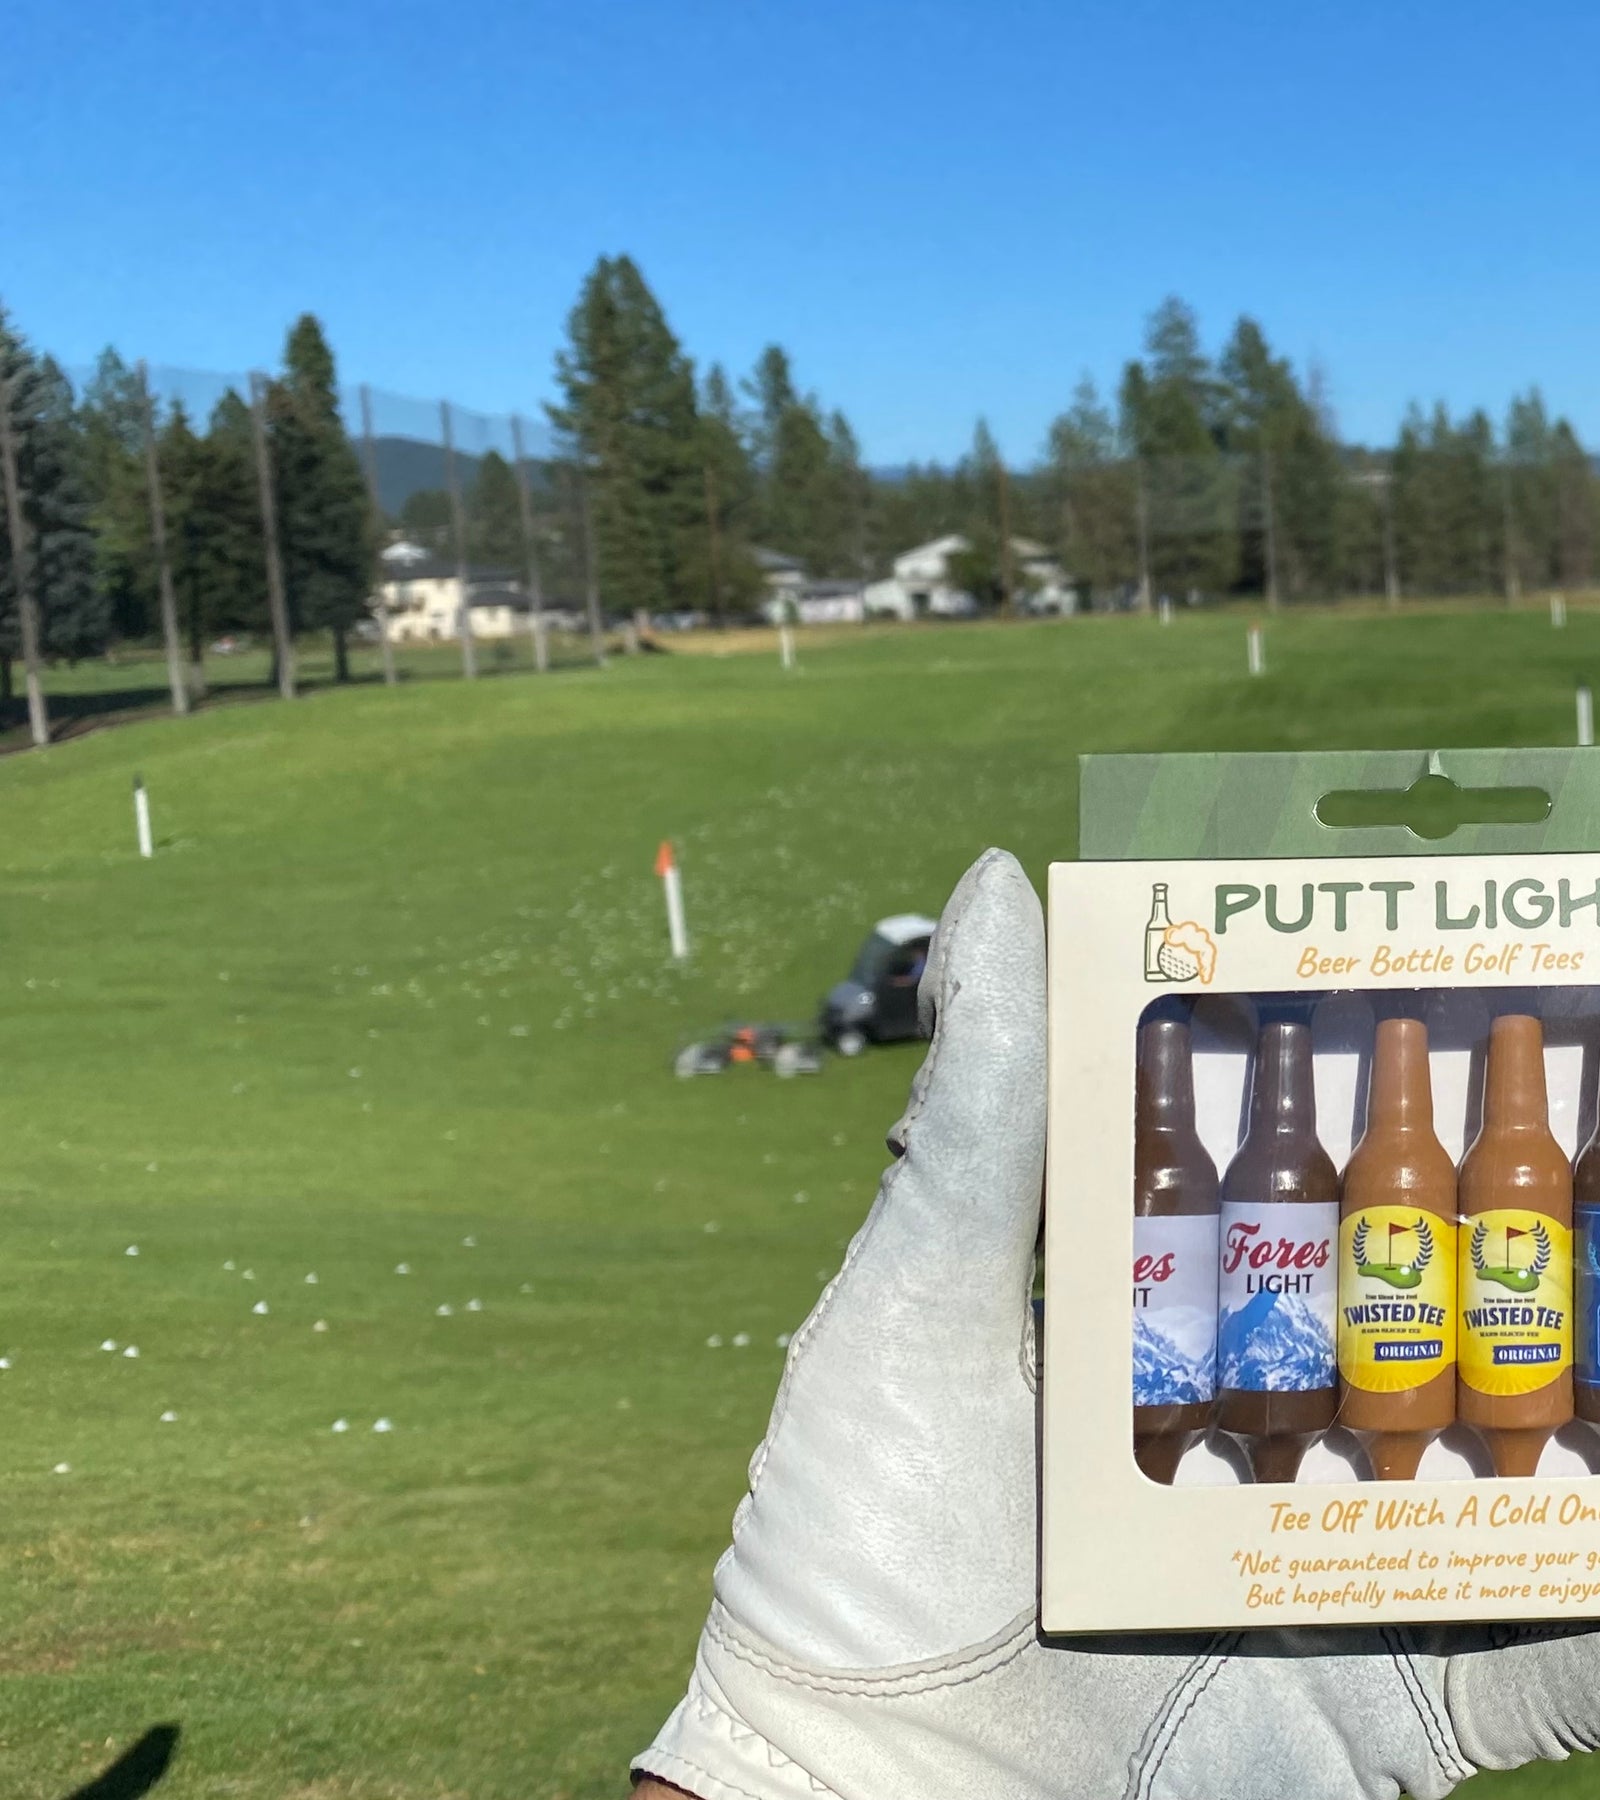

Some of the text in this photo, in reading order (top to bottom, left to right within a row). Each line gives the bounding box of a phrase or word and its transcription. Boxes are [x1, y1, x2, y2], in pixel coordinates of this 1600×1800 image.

[1214, 883, 1415, 935] PUTT
[1296, 943, 1584, 977] Beer Bottle Golf Tees
[1223, 1222, 1330, 1274] Fores
[1246, 1273, 1314, 1294] LIGHT
[1343, 1302, 1446, 1327] TWISTED TEE
[1463, 1306, 1564, 1331] TWISTED TEE
[1380, 1343, 1440, 1358] ORIGINAL
[1498, 1346, 1559, 1361] ORIGINAL
[1270, 1502, 1311, 1533] Tee
[1321, 1498, 1369, 1534] Off
[1374, 1498, 1445, 1531] With
[1456, 1495, 1478, 1528] A
[1490, 1494, 1551, 1528] Cold
[1289, 1548, 1413, 1579] guaranteed
[1418, 1551, 1440, 1570] to
[1447, 1551, 1527, 1575] improve
[1530, 1552, 1580, 1573] your
[1246, 1583, 1286, 1609] But
[1292, 1581, 1386, 1612] hopefully
[1393, 1578, 1448, 1600] make
[1455, 1582, 1472, 1600] it
[1479, 1583, 1531, 1599] more
